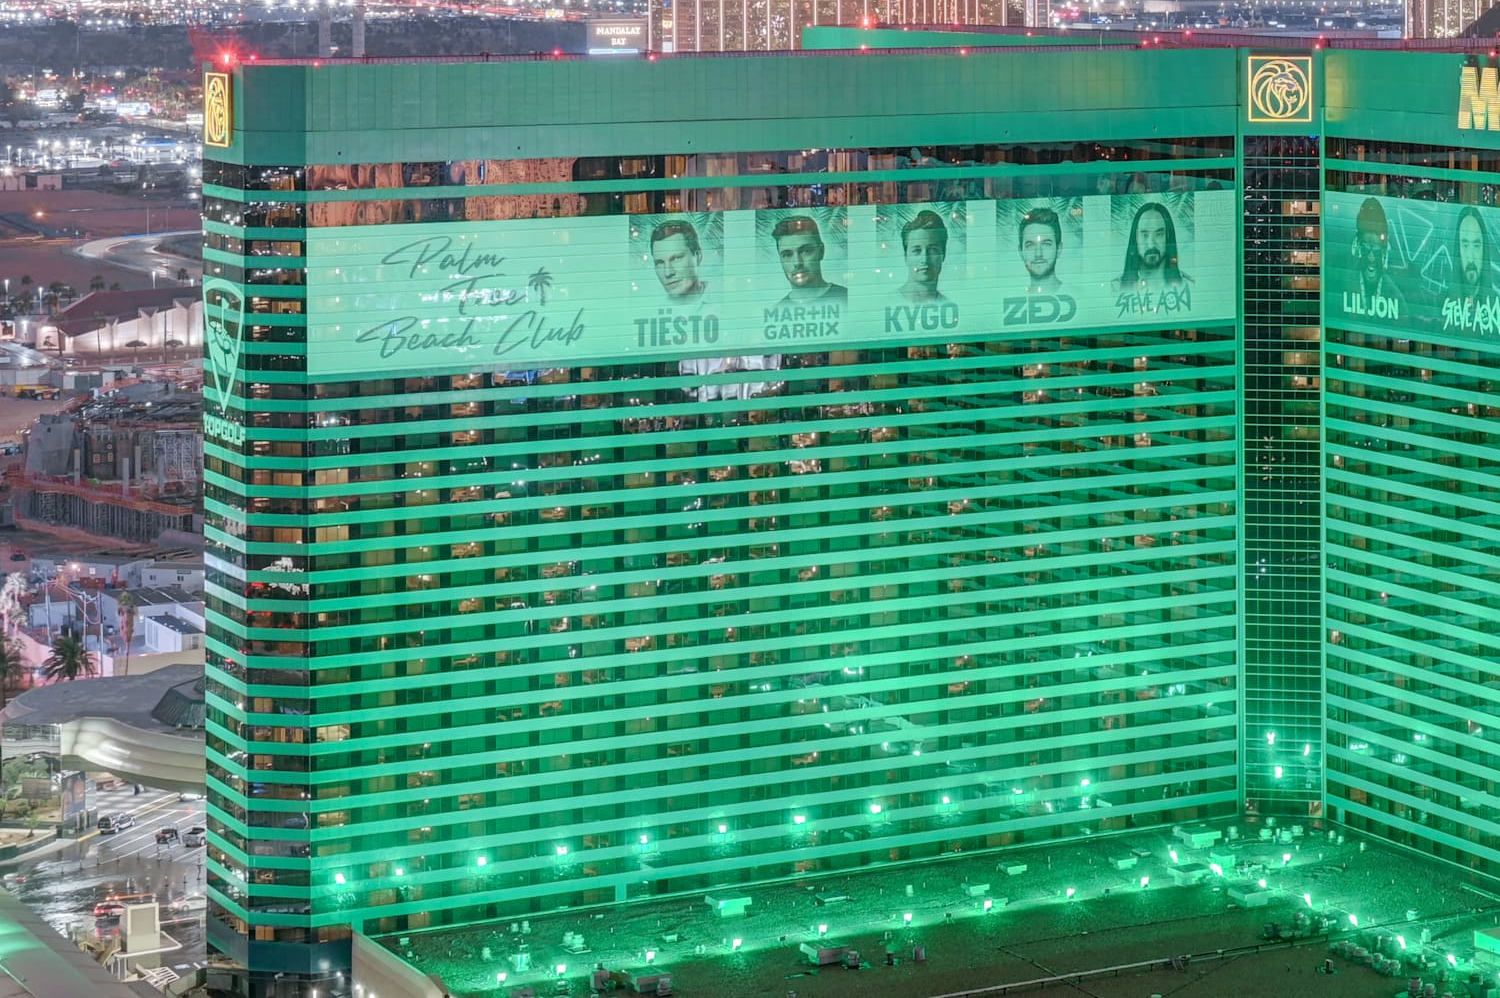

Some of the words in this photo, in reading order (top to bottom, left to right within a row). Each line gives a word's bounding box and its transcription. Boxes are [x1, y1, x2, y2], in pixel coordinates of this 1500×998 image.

[596, 26, 641, 35] MANDALAY
[611, 38, 626, 46] BAY
[381, 236, 505, 279] Palm
[884, 302, 960, 333] KYGO
[1343, 291, 1366, 315] LIL
[1367, 295, 1399, 320] JON
[1441, 297, 1473, 331] STEVE
[355, 316, 481, 359] Beach
[494, 307, 584, 356] Club
[634, 308, 719, 348] TIËSTO
[764, 321, 840, 341] GARRIX
[203, 411, 246, 446] TOPGOLF
